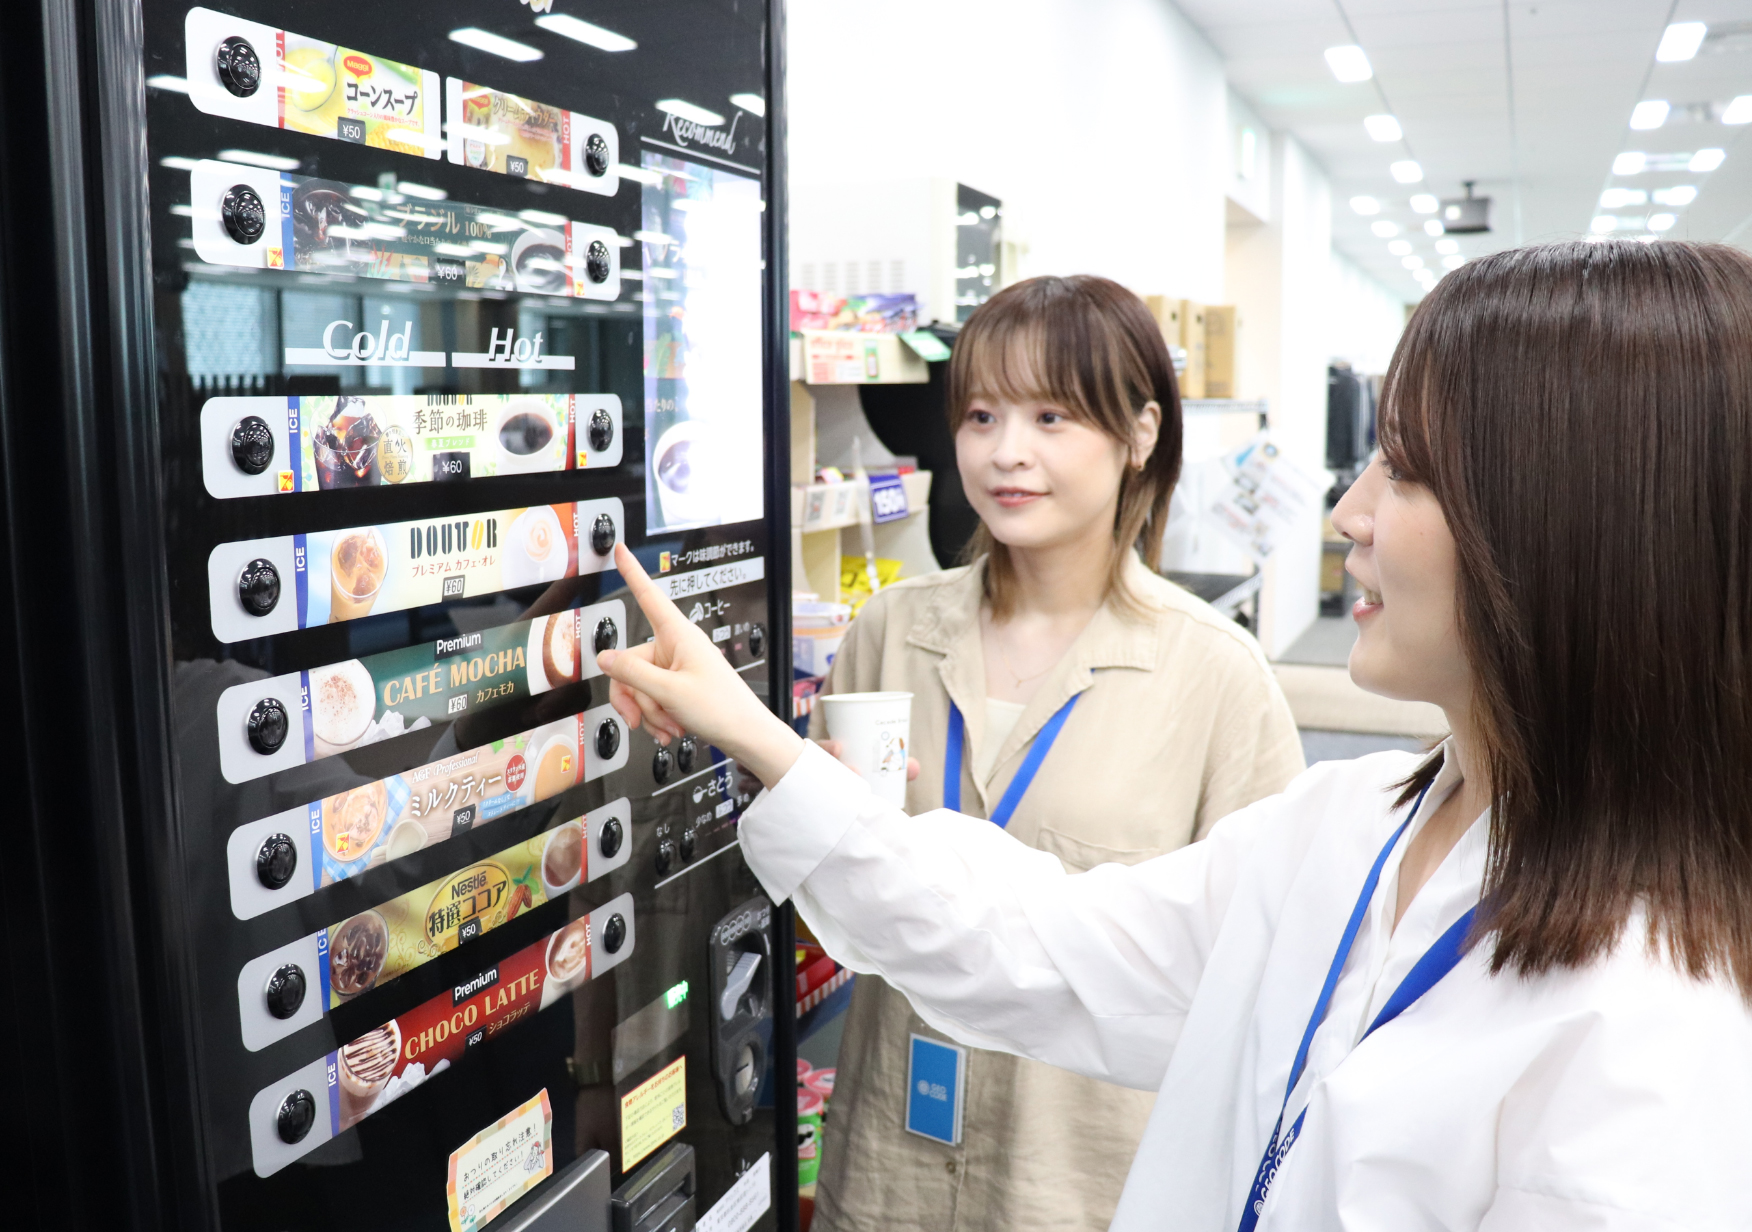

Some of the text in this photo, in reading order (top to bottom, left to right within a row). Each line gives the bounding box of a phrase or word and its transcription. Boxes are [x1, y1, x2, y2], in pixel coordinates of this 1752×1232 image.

[346, 60, 369, 71] Maggi
[346, 81, 418, 116] コーンスープ
[342, 124, 361, 139] ¥50
[662, 110, 743, 155] Recommend
[510, 160, 524, 173] ¥50
[281, 192, 290, 218] ICE
[464, 220, 492, 239] 100%
[437, 265, 458, 280] ¥60
[322, 318, 412, 363] Cold
[488, 326, 545, 365] Hot
[289, 407, 298, 434] ICE
[413, 408, 488, 435] 季節の珈琲
[382, 438, 407, 454] 直火
[430, 437, 471, 449] 春夏ブレンド
[383, 459, 407, 476] 焙煎
[442, 459, 463, 475] ¥60
[572, 511, 580, 538] HOT
[410, 518, 497, 559] DOUTOR
[296, 546, 306, 572] ICE
[412, 563, 453, 578] プレミアム
[445, 578, 464, 595] ¥60
[669, 567, 747, 597] 先に押してください。
[704, 599, 731, 619] コーヒー
[436, 631, 482, 656] Premium
[383, 645, 526, 707] CAFÉ MOCHA
[301, 685, 310, 712] ICE
[448, 694, 468, 714] ¥60
[475, 681, 515, 704] カフェモカ
[412, 750, 480, 784] AGF Professional
[411, 774, 502, 817] ミルクティー
[707, 771, 733, 797] さとう
[310, 809, 320, 835] ICE
[456, 810, 471, 824] ¥50
[656, 823, 670, 838] なし
[450, 872, 488, 900] Nestlé
[428, 879, 508, 937] 特選ココア
[318, 928, 327, 956] ICE
[461, 923, 477, 938] ¥50
[454, 969, 498, 1002] Premium
[404, 968, 540, 1060] CHOCO LATTE
[488, 1003, 531, 1035] ショコラッテ
[468, 1031, 483, 1047] ¥50
[327, 1062, 337, 1087] ICE
[463, 1122, 536, 1183] おつりの取り忘れ注意！
